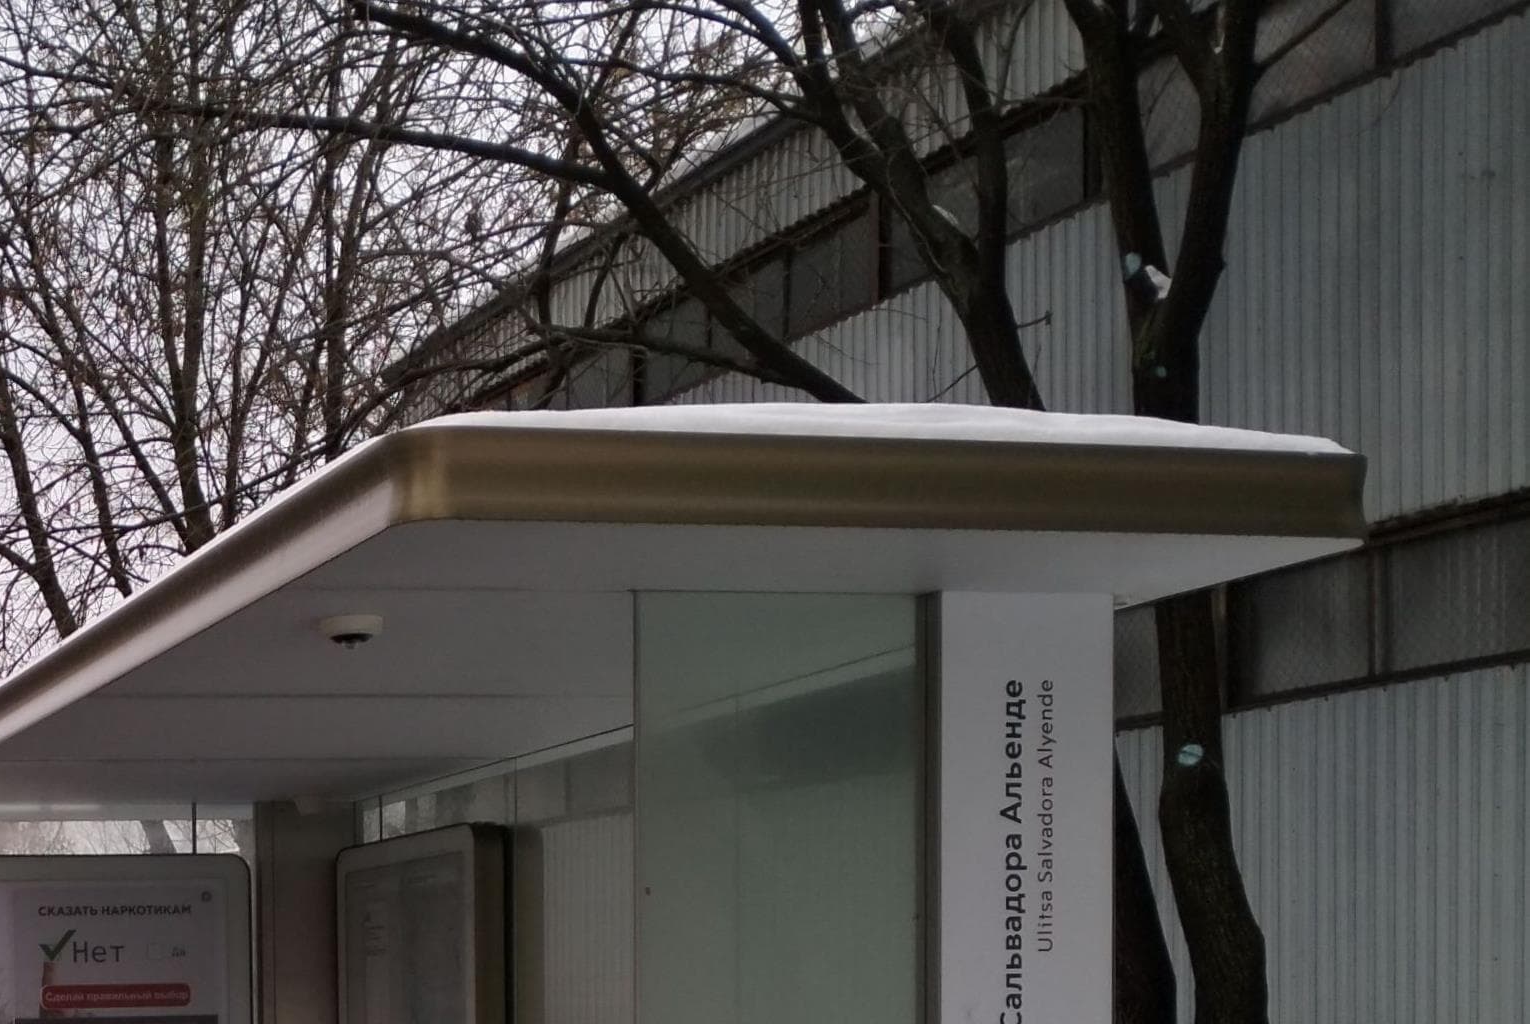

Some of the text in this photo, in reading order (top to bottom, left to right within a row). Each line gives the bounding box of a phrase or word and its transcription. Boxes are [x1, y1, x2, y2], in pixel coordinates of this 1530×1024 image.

[999, 679, 1026, 824] Альенде
[1037, 679, 1058, 953] Ulitsa Salvadora Alyende
[37, 904, 192, 917] СКАЗАТЬ НАРКОТИКАМ
[72, 941, 125, 963] Нет
